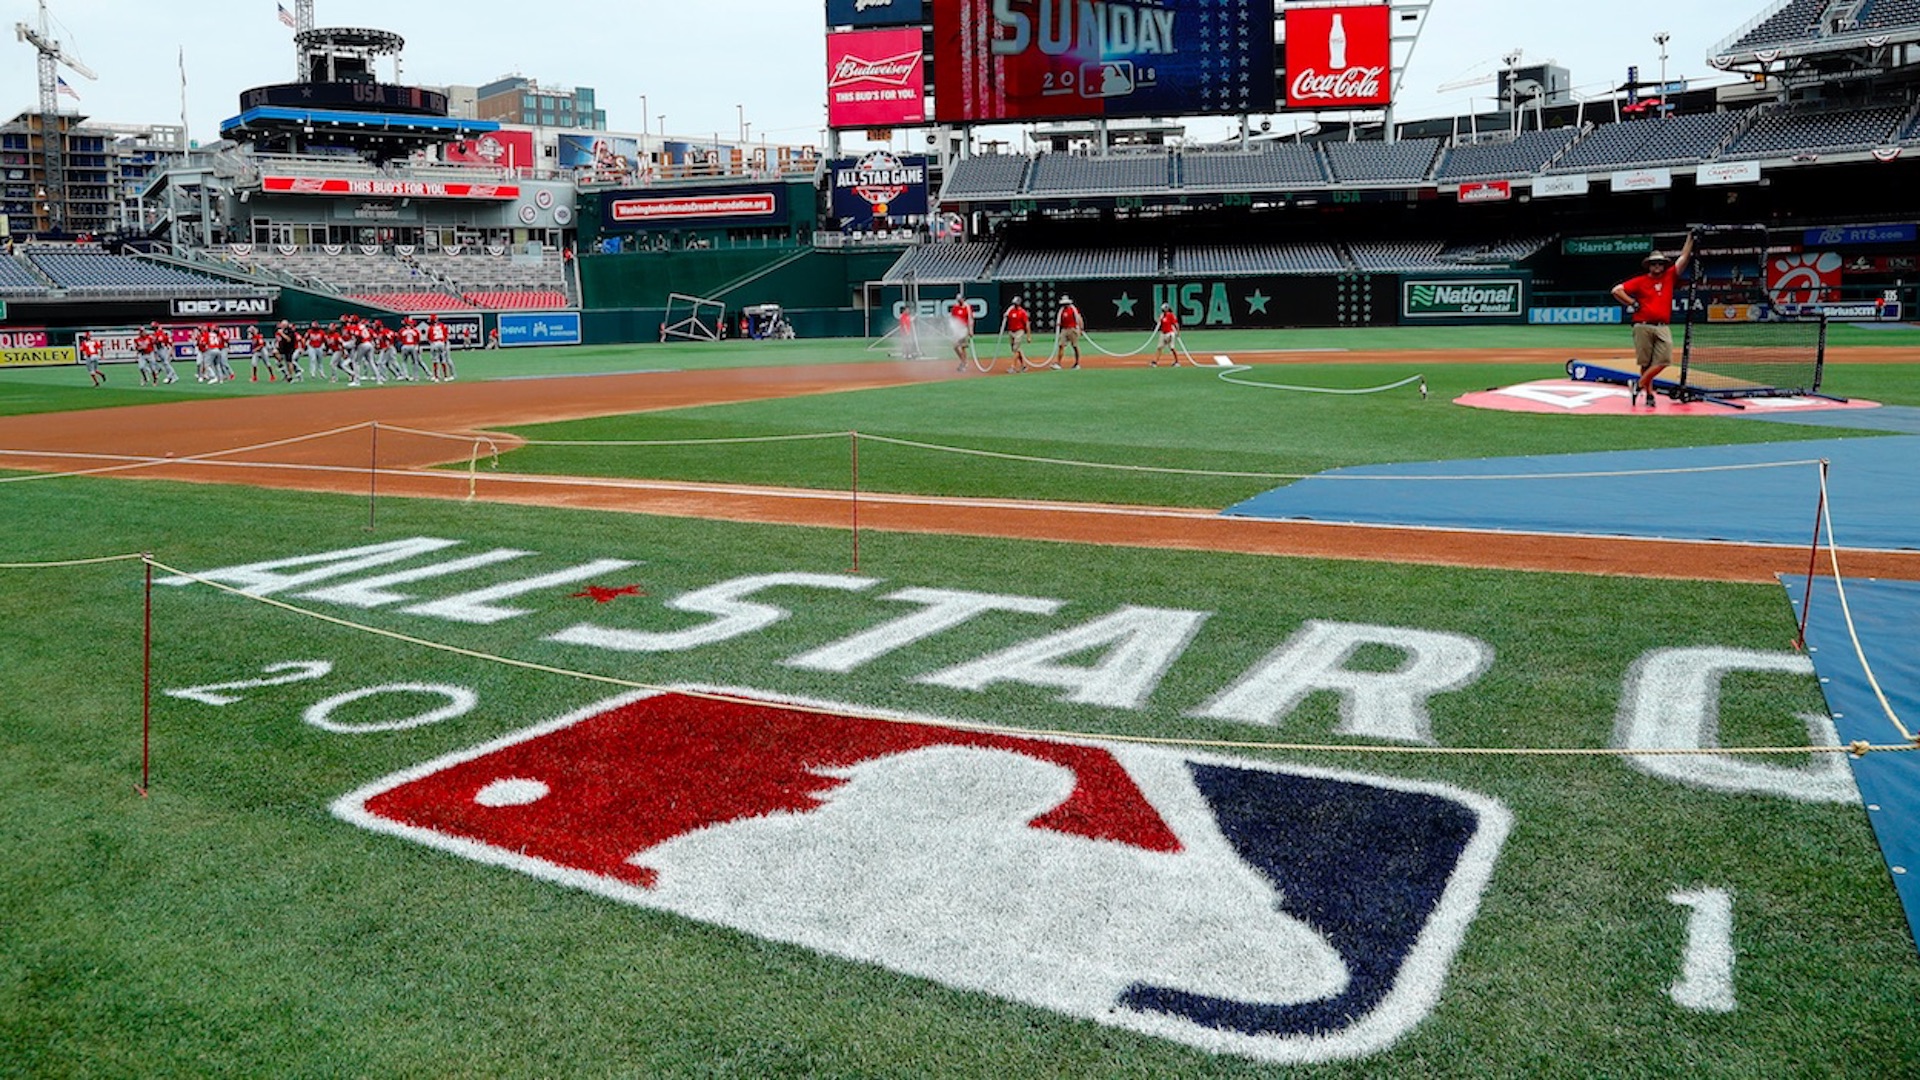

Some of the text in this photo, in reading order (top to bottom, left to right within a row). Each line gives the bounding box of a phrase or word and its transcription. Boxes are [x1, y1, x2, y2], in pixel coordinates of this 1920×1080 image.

[991, 0, 1176, 55] SUNDAY
[836, 60, 911, 78] Budweiser
[1043, 68, 1156, 88] 20 18
[1291, 66, 1384, 100] Coca-Cola
[352, 84, 386, 103] USA
[835, 88, 917, 102] THIS BUD'S FOR YOU.
[837, 168, 924, 188] ALL STAR GAME
[349, 180, 447, 195] THIS BUD'S FOR YOU.
[1223, 193, 1251, 206] USA
[1332, 190, 1361, 203] USA
[1850, 229, 1903, 241] RTS.com
[1578, 240, 1650, 252] Harris Teeter
[1433, 285, 1515, 304] National
[225, 300, 267, 312] FAN
[1152, 282, 1233, 326] USA
[1460, 304, 1510, 313] Car Rental
[1671, 298, 1704, 311] LTA
[1552, 307, 1614, 322] KOCH
[4, 350, 69, 362] STANLEY
[150, 536, 645, 624] ALL
[540, 572, 1497, 745] STAR
[1665, 884, 1737, 1013] 1
